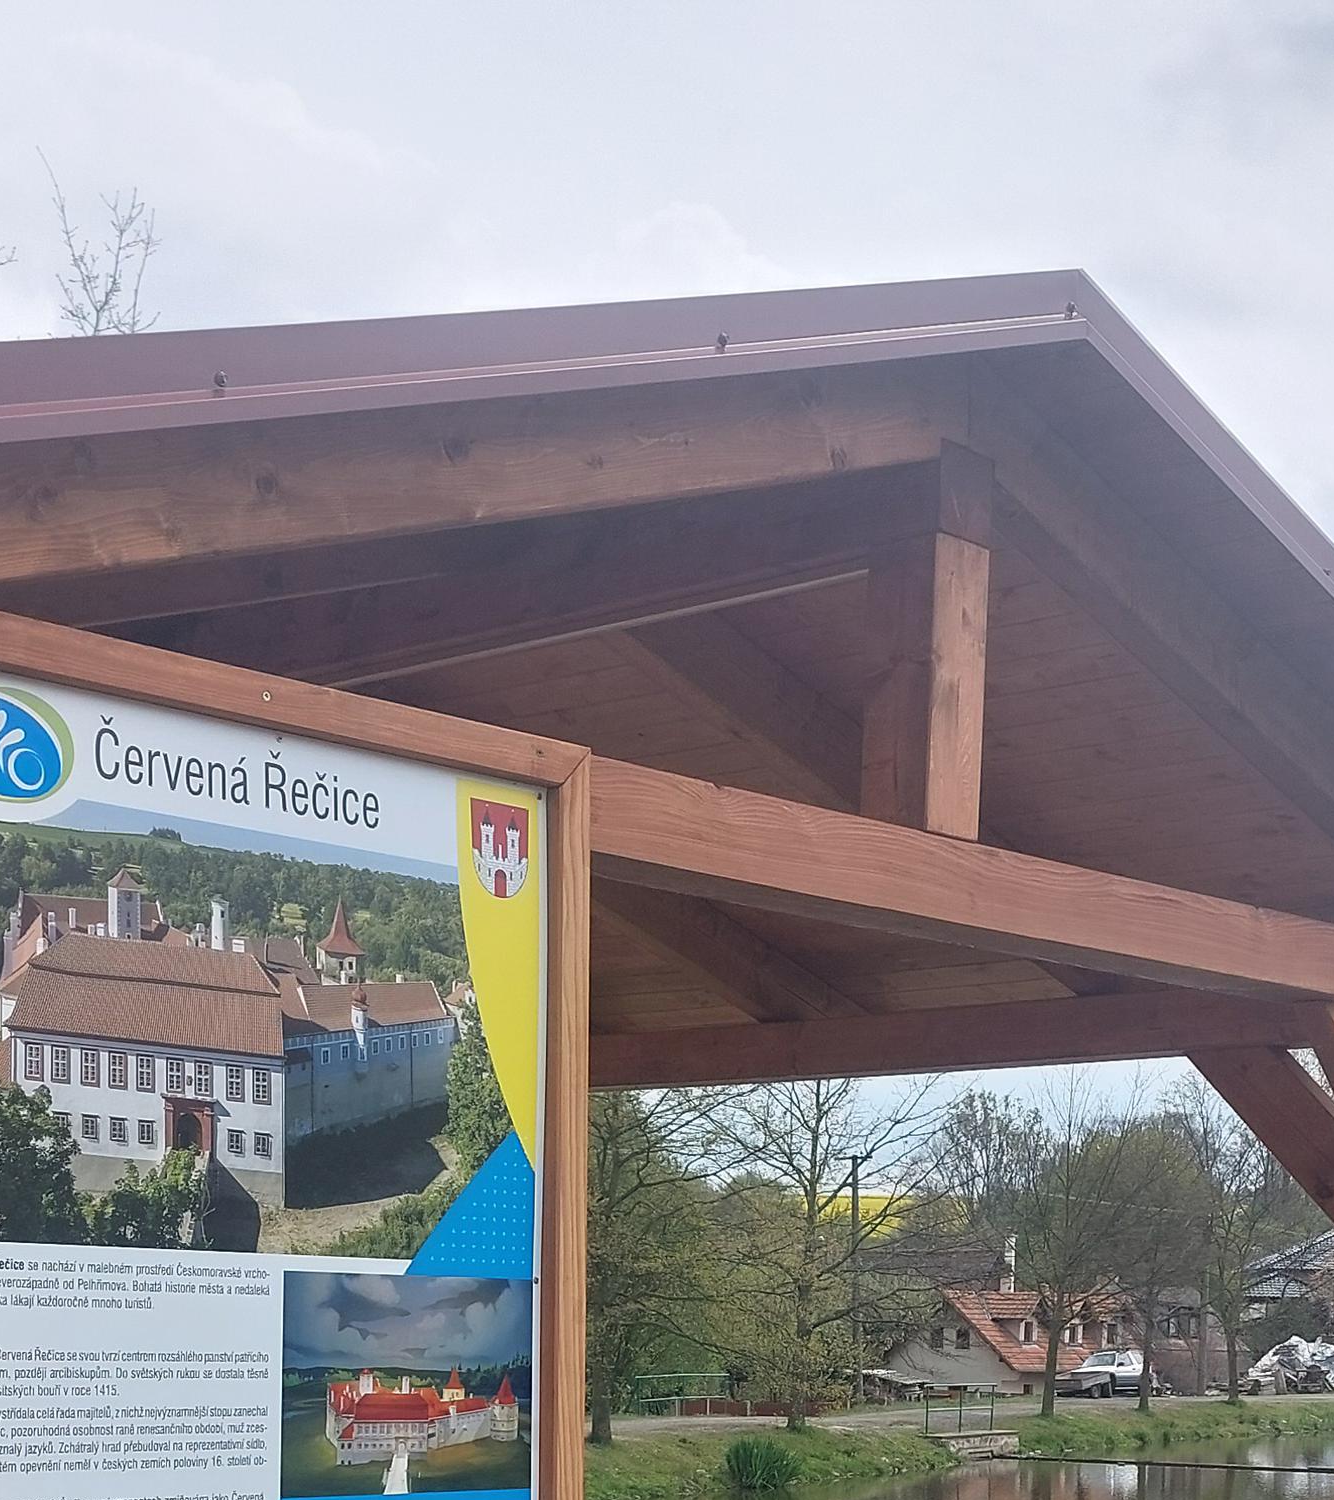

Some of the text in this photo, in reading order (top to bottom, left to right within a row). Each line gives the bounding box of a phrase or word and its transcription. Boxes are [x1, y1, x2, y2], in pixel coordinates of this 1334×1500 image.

[94, 715, 380, 830] Červená Řečice
[42, 1260, 76, 1272] nachází
[87, 1262, 133, 1274] malebném
[244, 1267, 270, 1279] vrcho-
[62, 1278, 73, 1289] od
[132, 1280, 161, 1292] Bohatá
[164, 1281, 195, 1293] historie
[198, 1281, 223, 1294] města
[234, 1283, 270, 1295] nedaleká
[10, 1294, 34, 1309] lákají
[36, 1295, 88, 1308] každoročně
[91, 1297, 122, 1308] mnoho
[34, 1348, 65, 1361] Řečice
[14, 1366, 46, 1380] později
[37, 1384, 60, 1396] bouří
[70, 1387, 91, 1396] roce
[36, 1406, 54, 1418] celá
[55, 1406, 75, 1418] řada
[232, 1405, 268, 1417] zanechal
[10, 1424, 70, 1439] pozoruhodná
[72, 1423, 113, 1435] osobnost
[115, 1422, 134, 1434] rané
[24, 1441, 55, 1456] jazyků.
[58, 1441, 99, 1455] Zchátralý
[101, 1441, 120, 1452] hrad
[19, 1459, 61, 1474] opevnění
[63, 1458, 90, 1470] neměl
[101, 1457, 137, 1471] českých
[140, 1456, 170, 1468] zemích
[173, 1456, 208, 1470] poloviny
